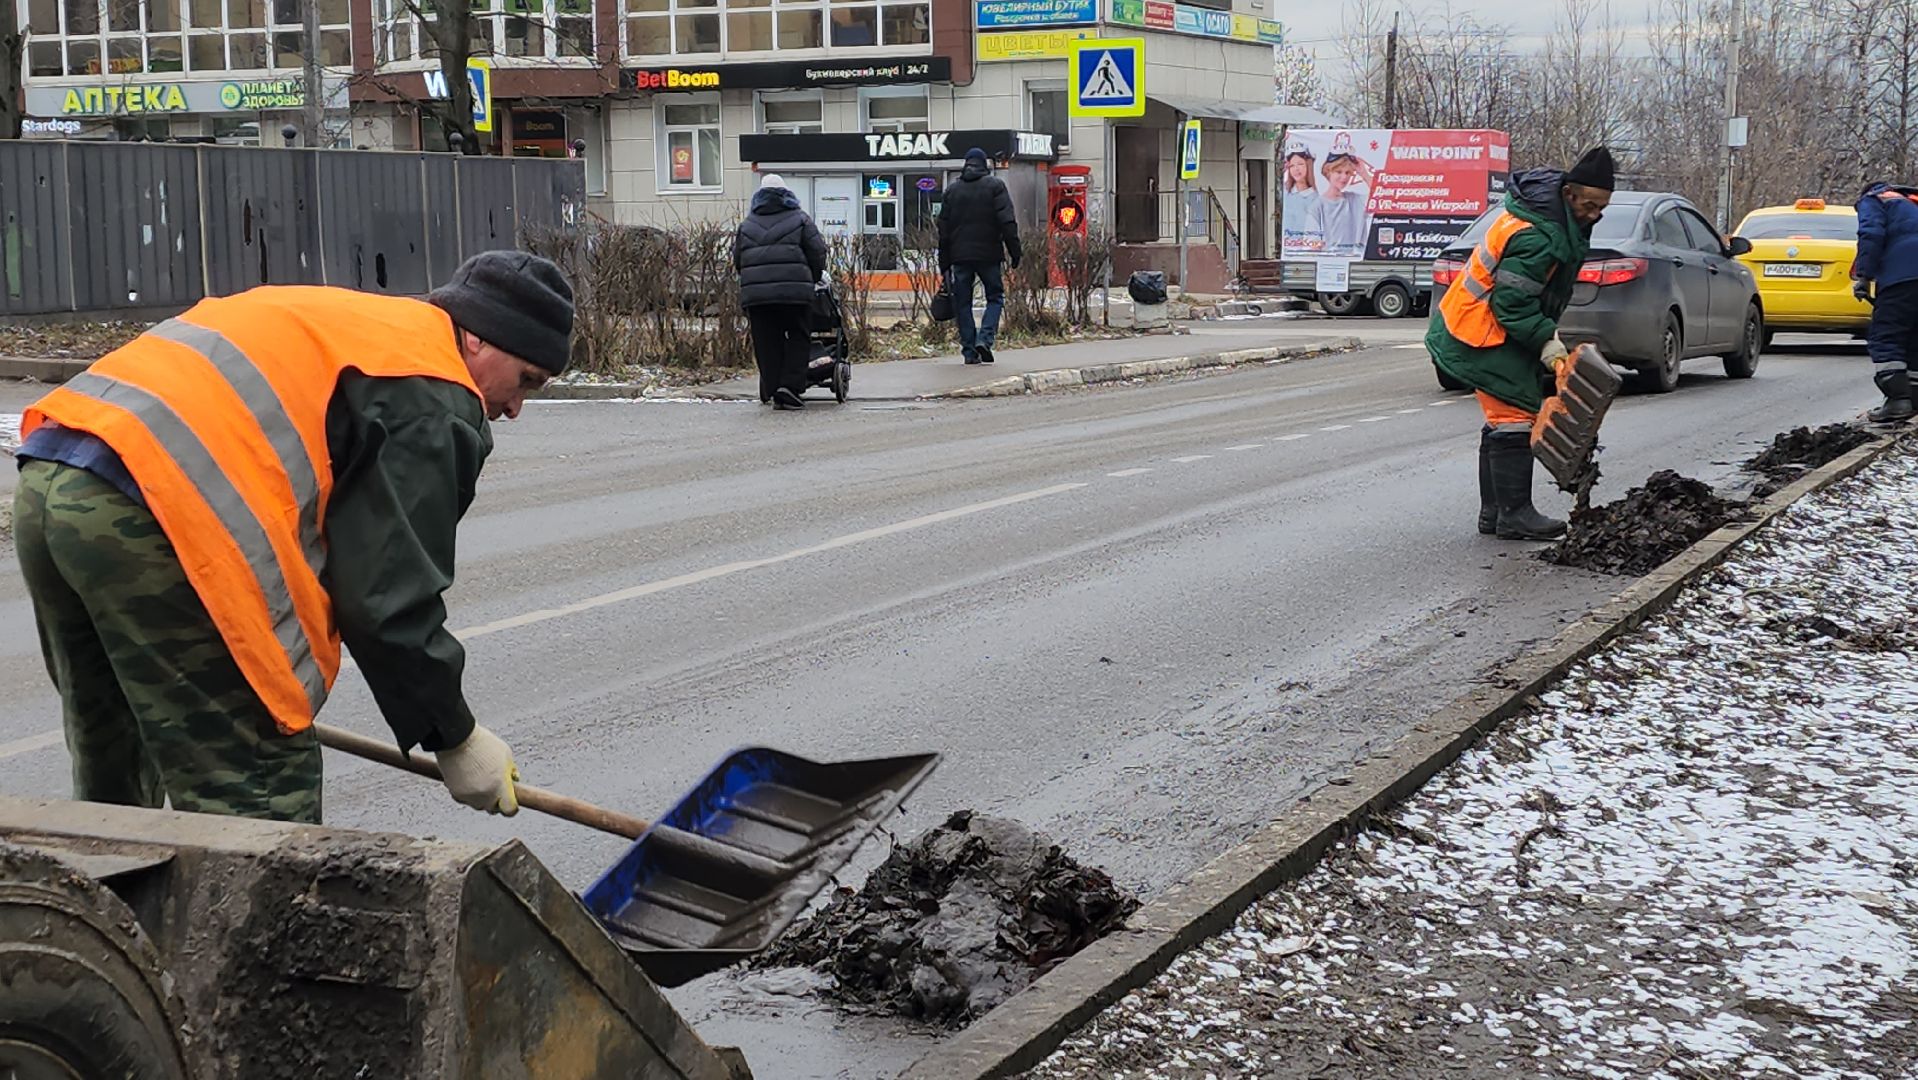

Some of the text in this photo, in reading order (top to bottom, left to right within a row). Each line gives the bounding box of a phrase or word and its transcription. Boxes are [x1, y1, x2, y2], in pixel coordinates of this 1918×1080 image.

[1205, 12, 1230, 34] ОСАГО
[986, 33, 1068, 54] ЦВЕТЫ
[637, 69, 720, 88] BetBoom
[906, 64, 929, 75] 24/7
[62, 84, 188, 114] АПТЕКА
[21, 119, 81, 133] Stardogs
[865, 132, 950, 157] ТАБАК
[1017, 132, 1053, 156] ТАБАК
[1391, 146, 1484, 160] WARPOINT
[1431, 198, 1480, 212] Warpoint
[1402, 247, 1421, 258] 925
